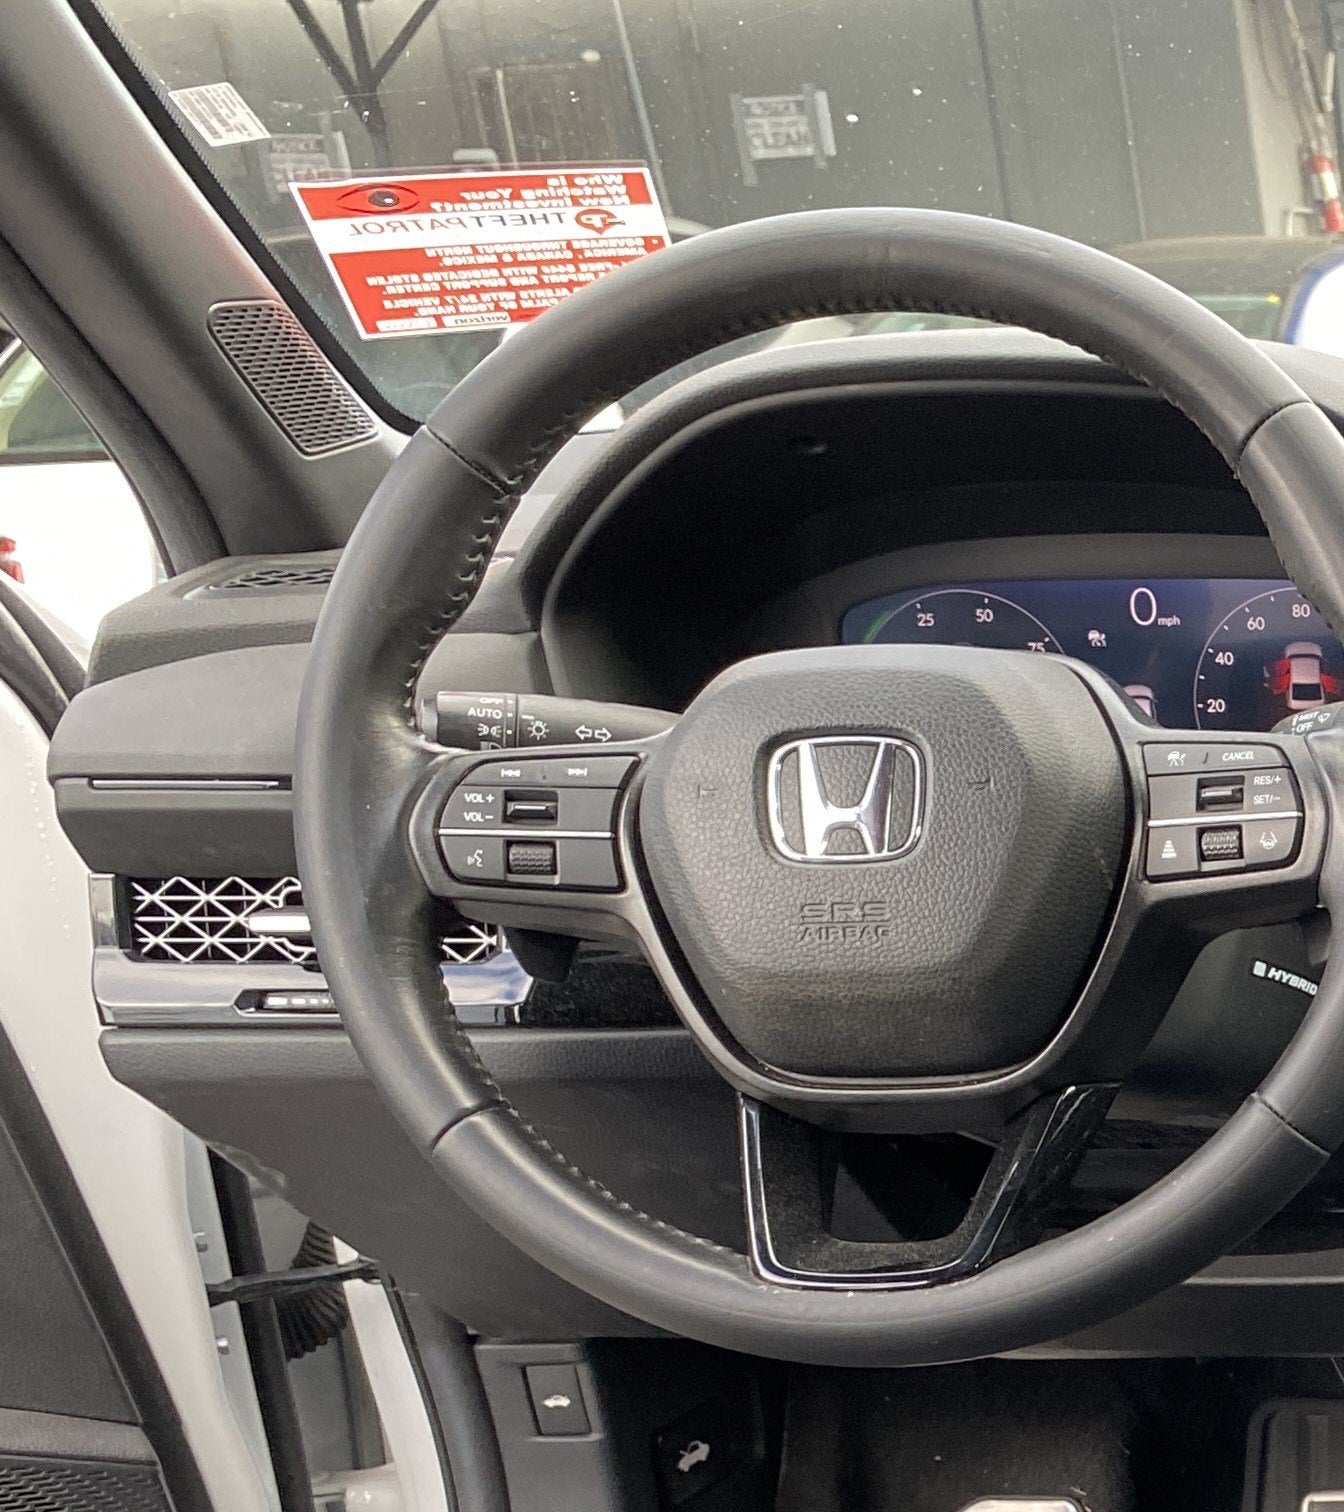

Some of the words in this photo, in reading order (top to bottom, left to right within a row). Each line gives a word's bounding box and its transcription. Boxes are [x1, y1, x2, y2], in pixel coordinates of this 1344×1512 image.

[1130, 587, 1156, 626] 0
[1158, 615, 1180, 627] mph
[1292, 604, 1310, 617] 80
[917, 614, 934, 627] 25
[976, 609, 993, 622] 50
[1247, 617, 1265, 630] 60
[1215, 652, 1234, 665] 40
[1207, 699, 1226, 713] 20
[467, 707, 503, 719] AUTO
[1296, 722, 1314, 733] OFF
[1222, 751, 1255, 762] CANCEL
[801, 901, 888, 921] SRS
[1267, 967, 1318, 996] HYBRID
